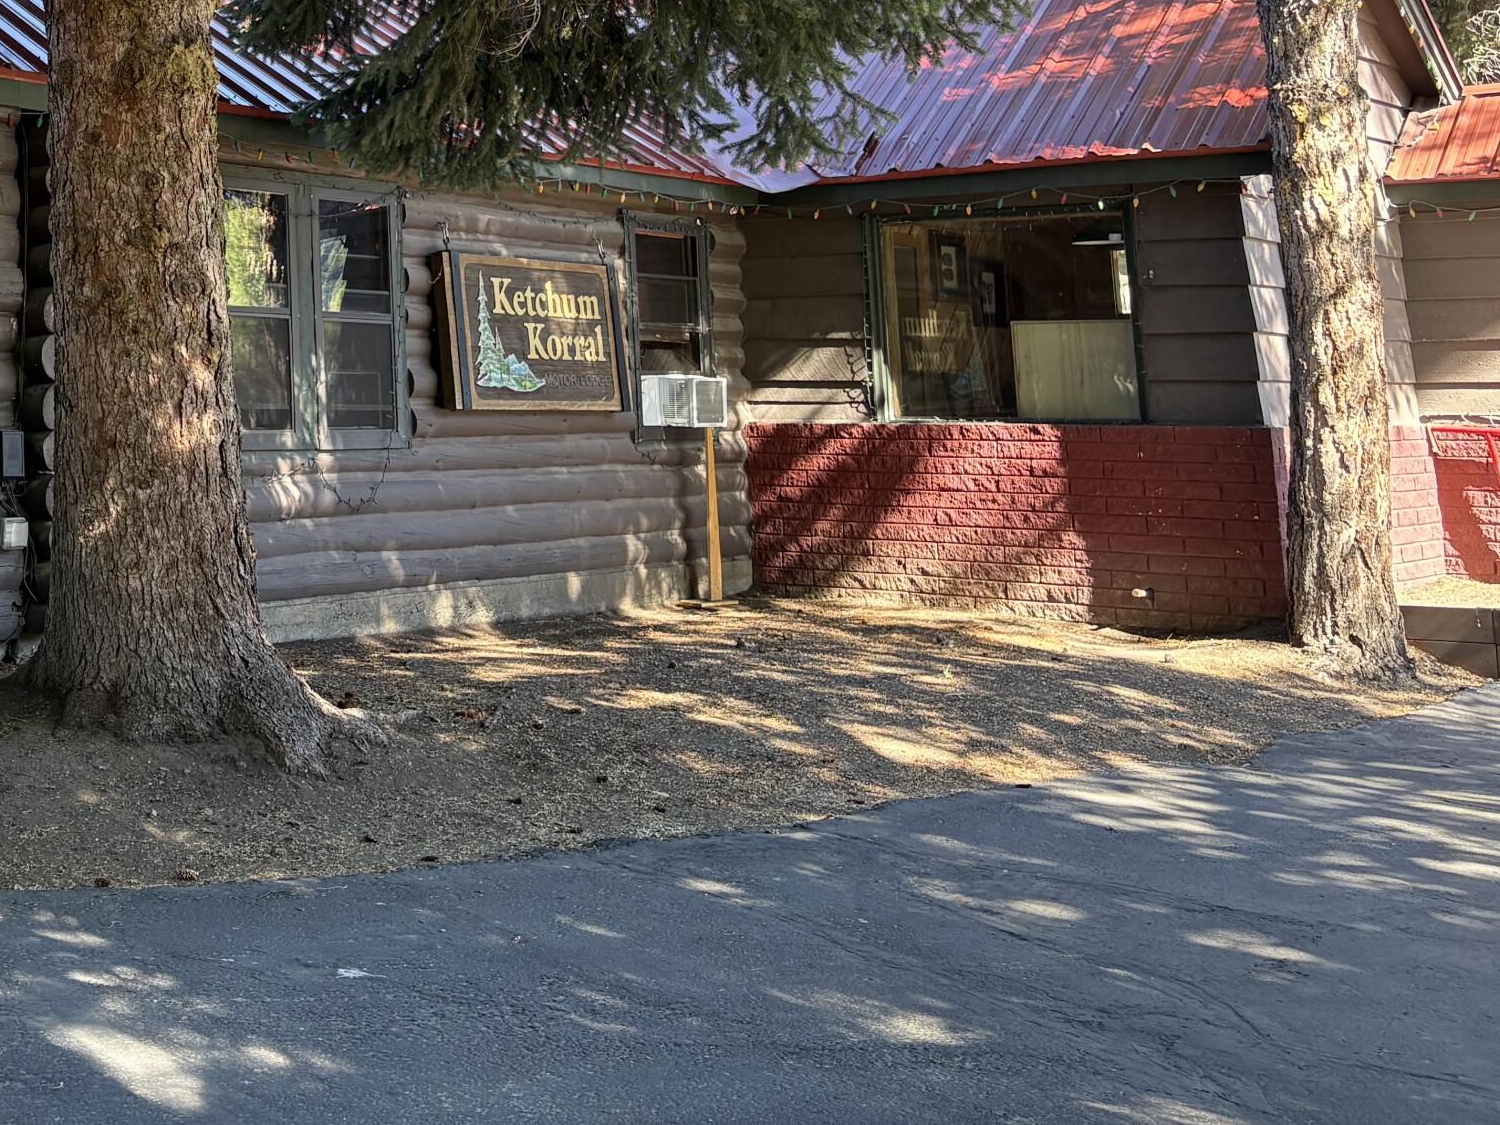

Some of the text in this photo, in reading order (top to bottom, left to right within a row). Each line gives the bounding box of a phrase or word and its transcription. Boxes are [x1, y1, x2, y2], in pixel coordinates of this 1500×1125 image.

[490, 277, 601, 319] Ketchum
[524, 323, 606, 362] Korral
[545, 372, 612, 388] MOTOR LODGE
